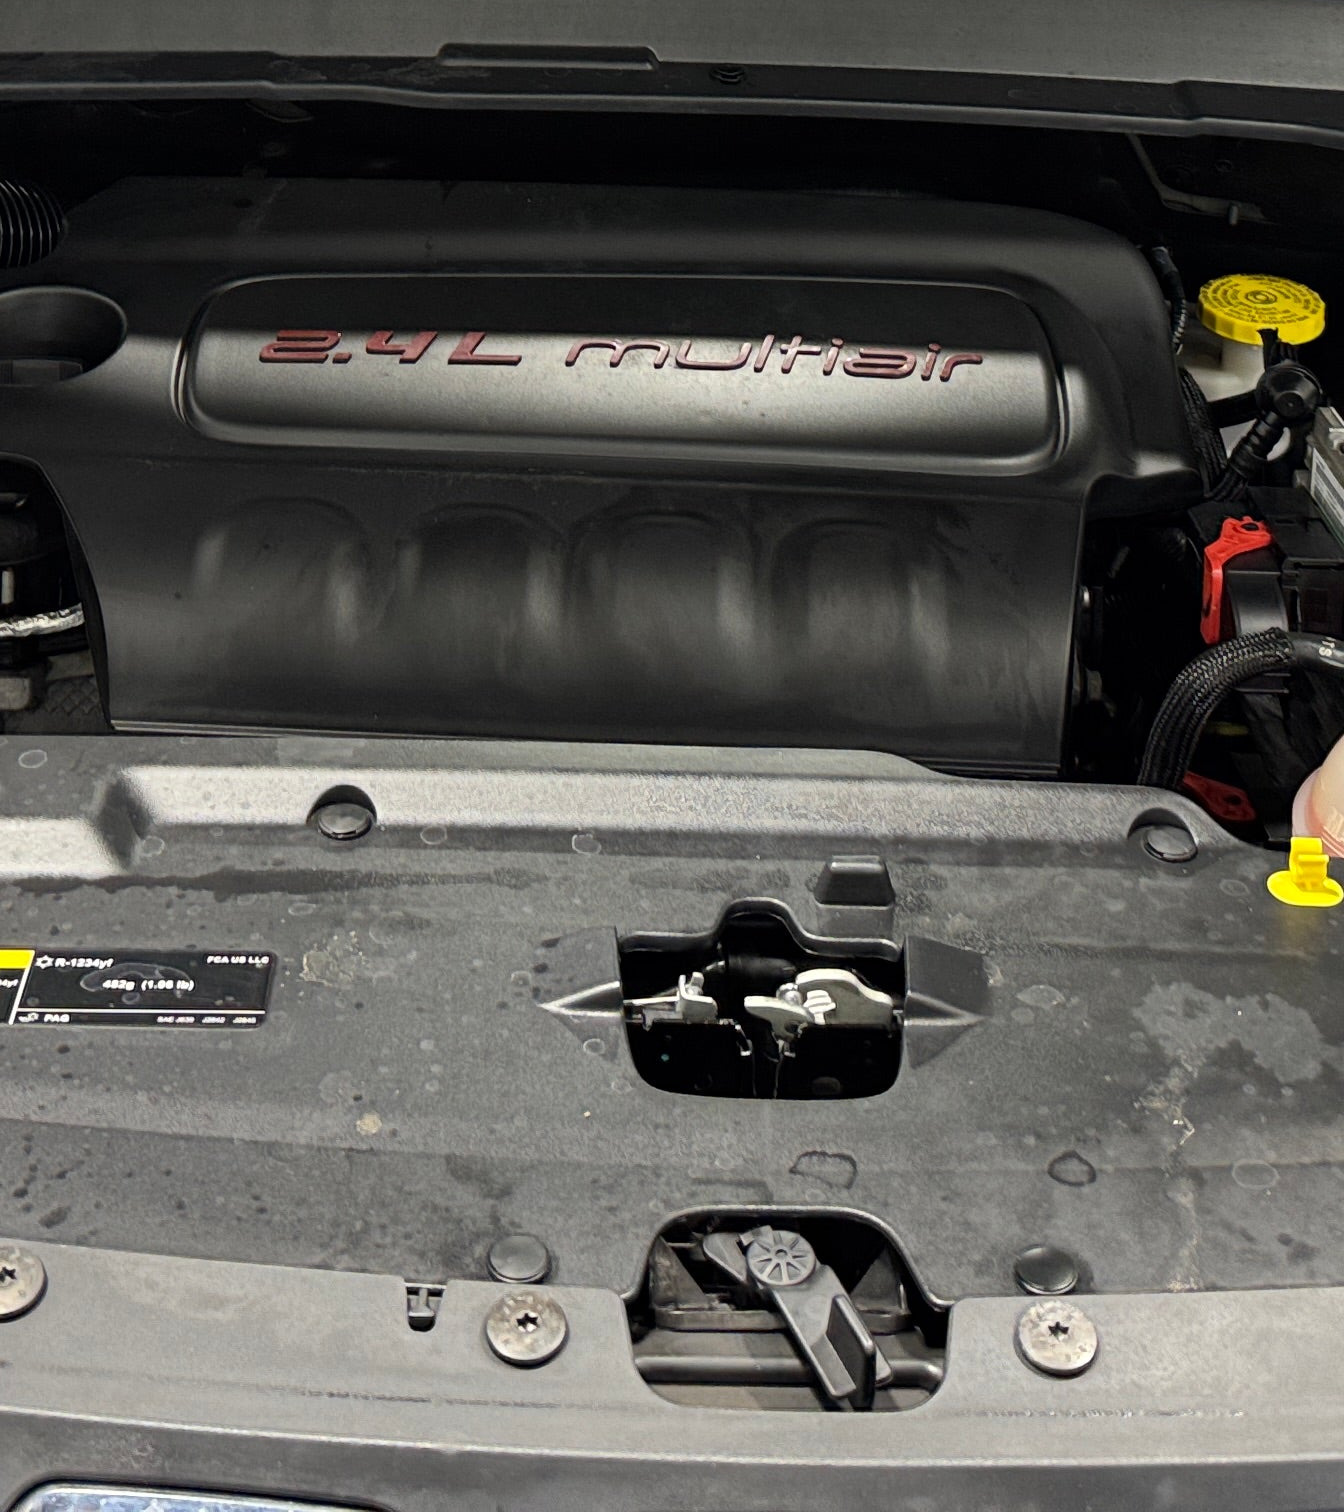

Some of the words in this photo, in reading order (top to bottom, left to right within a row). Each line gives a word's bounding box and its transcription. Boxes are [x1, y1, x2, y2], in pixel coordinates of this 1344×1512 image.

[259, 330, 523, 365] 2.4L
[564, 333, 984, 382] multiair
[54, 957, 114, 970] R-1234yf
[207, 955, 229, 964] FCA
[230, 955, 247, 964] US
[248, 955, 270, 964] LLC
